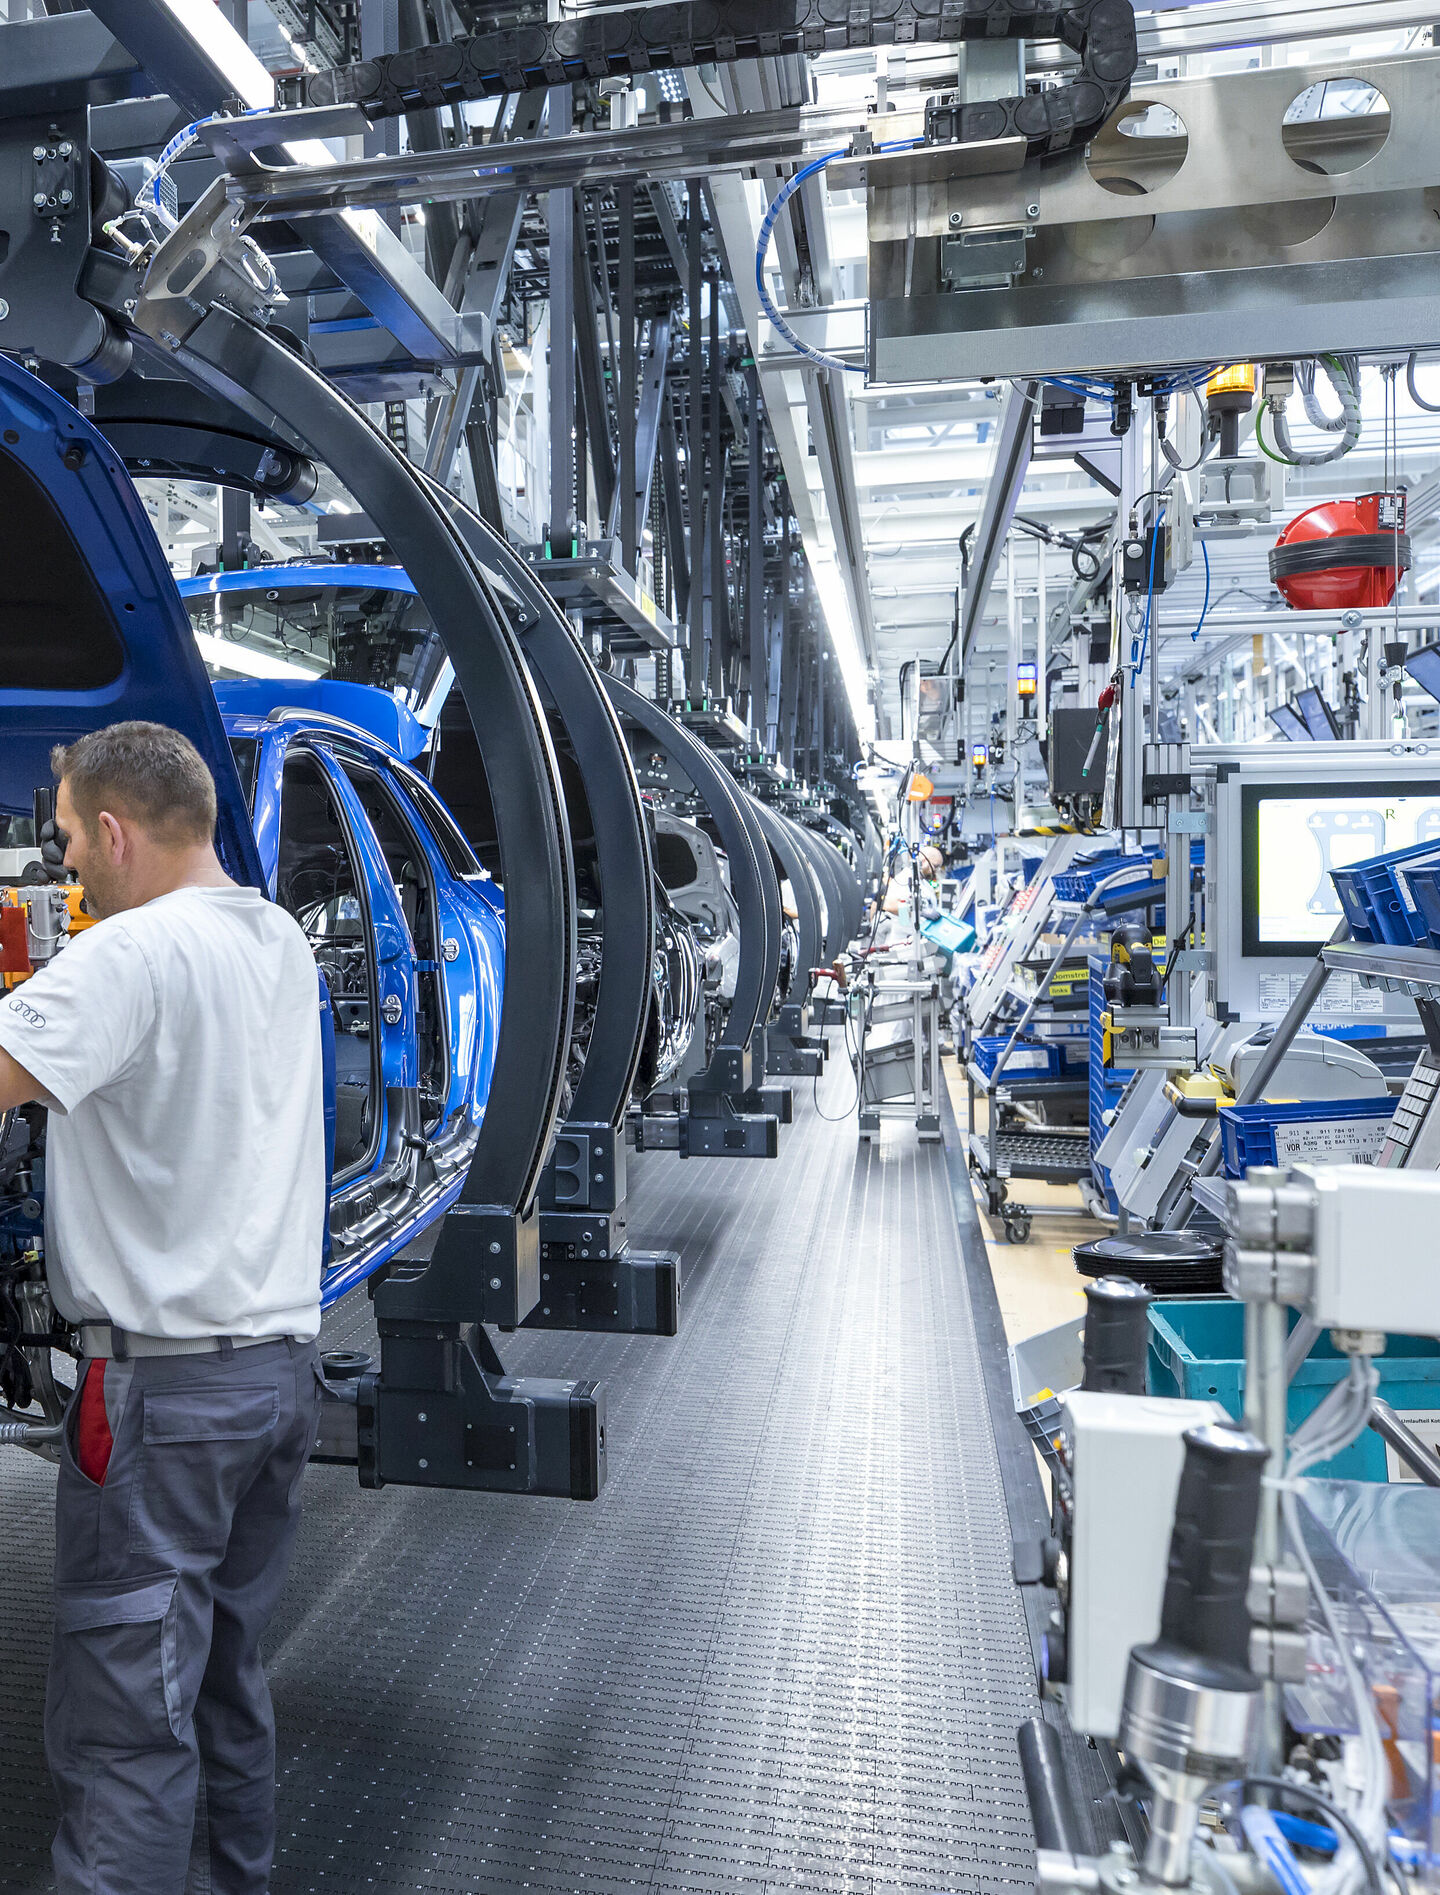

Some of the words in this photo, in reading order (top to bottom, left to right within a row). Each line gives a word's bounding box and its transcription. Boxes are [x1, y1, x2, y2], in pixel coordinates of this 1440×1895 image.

[1385, 808, 1396, 820] R
[1067, 1023, 1090, 1033] 11
[1286, 1143, 1301, 1152] VOR
